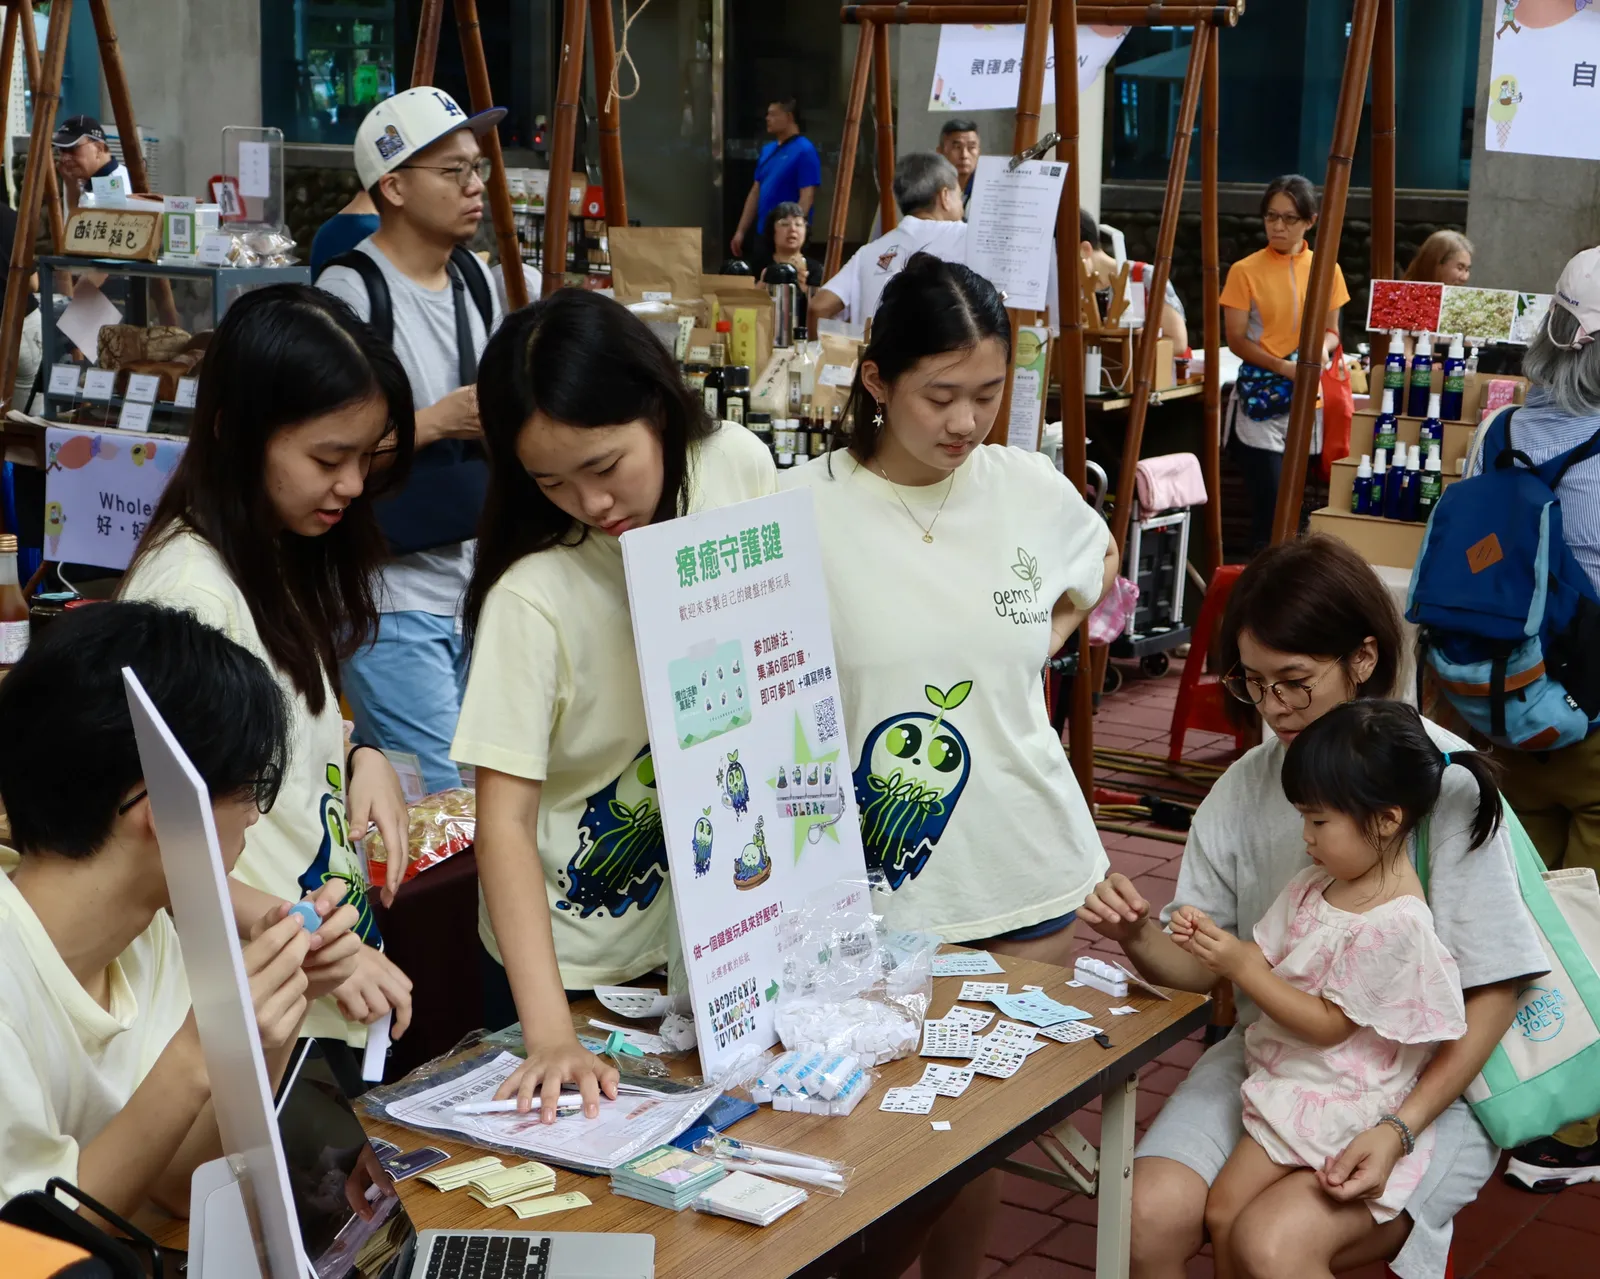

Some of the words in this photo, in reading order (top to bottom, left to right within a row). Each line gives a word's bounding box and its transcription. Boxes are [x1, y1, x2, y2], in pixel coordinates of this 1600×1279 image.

[1573, 61, 1597, 88] 自
[431, 92, 462, 117] LA
[675, 521, 784, 588] 療癒守護鍵
[678, 573, 791, 621] 歡迎來客製自己的鍵盤抒壓玩具
[993, 589, 1032, 617] gems
[760, 679, 796, 706] 即可參加
[1523, 1006, 1564, 1037] JOE'S
